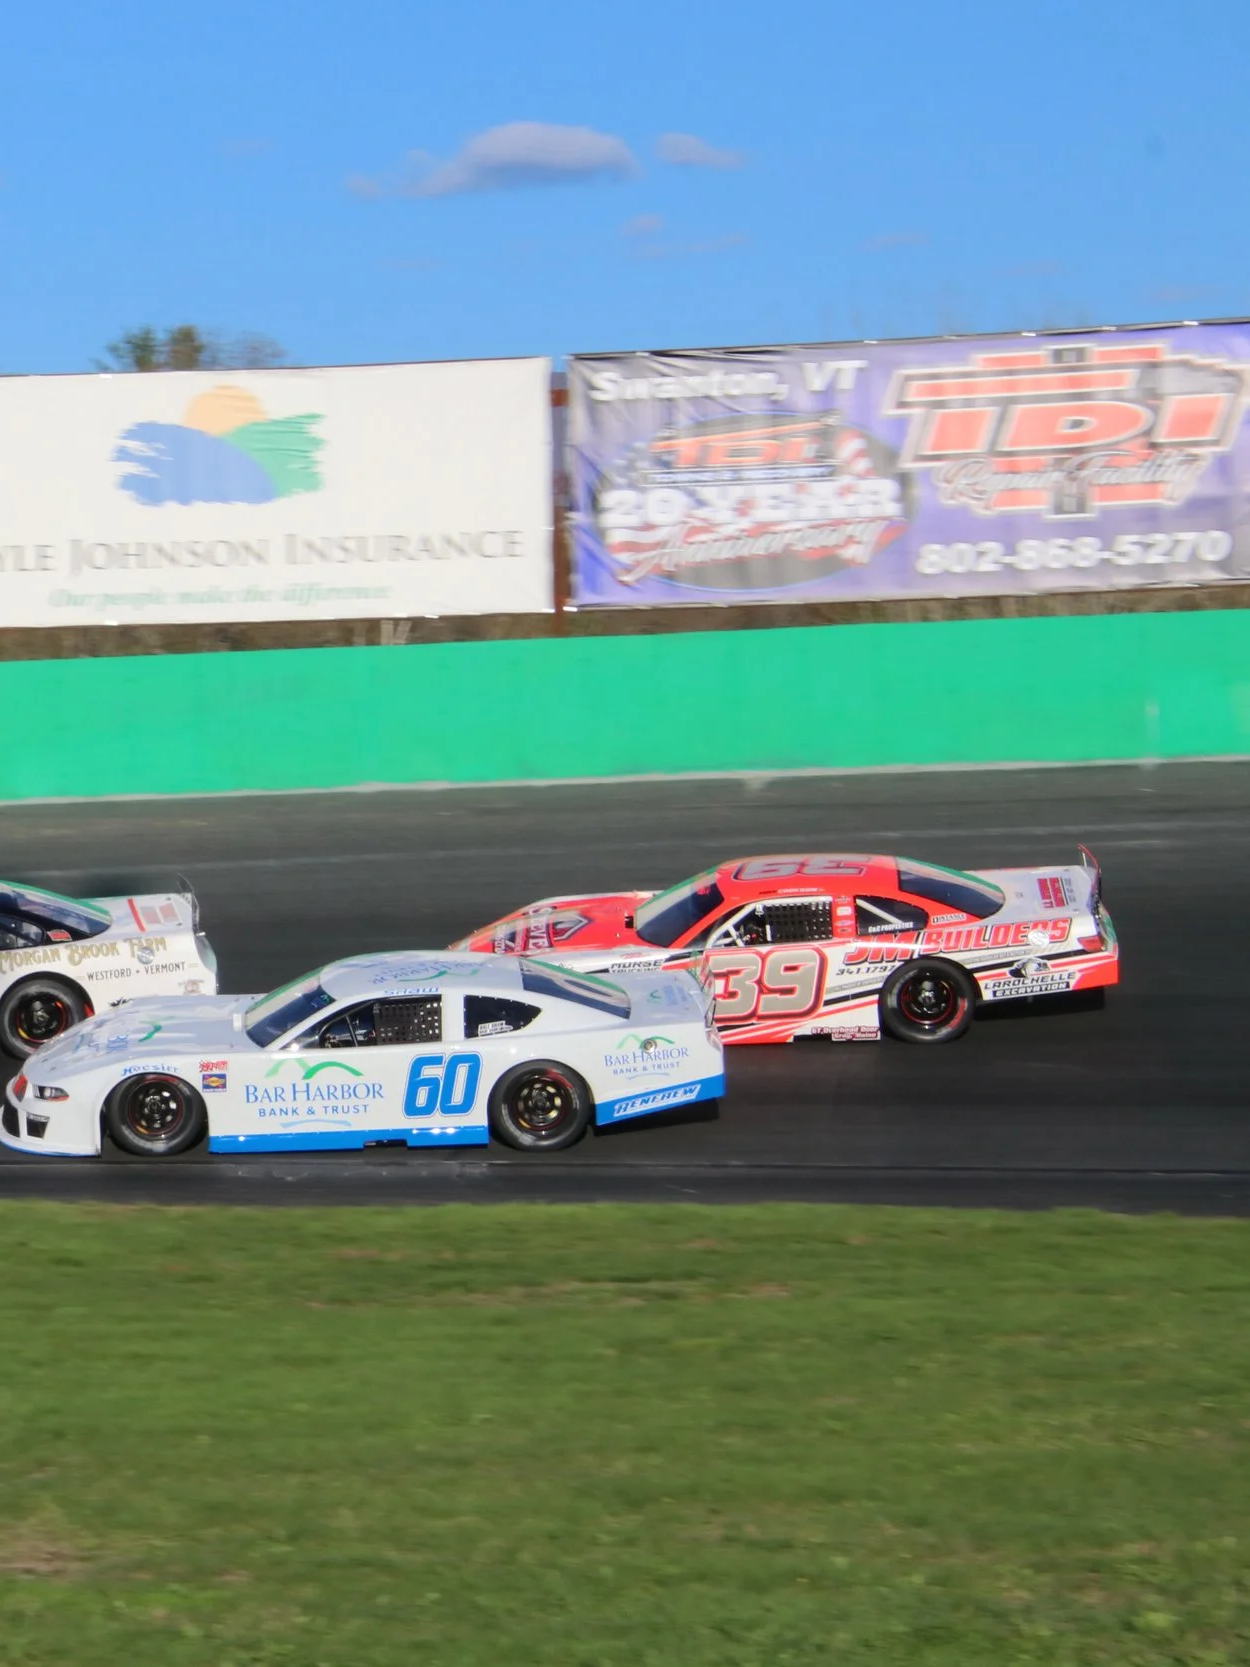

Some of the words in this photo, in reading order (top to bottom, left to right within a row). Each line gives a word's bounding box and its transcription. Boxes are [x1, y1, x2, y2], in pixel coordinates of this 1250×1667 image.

[802, 360, 868, 392] VT
[67, 537, 269, 575] JOHNSON
[282, 529, 526, 567] INSURANCE
[916, 529, 1233, 575] 802-868-5270
[67, 941, 120, 966] BROOK
[123, 936, 168, 958] FARM
[86, 968, 132, 981] WESTFORD
[143, 961, 186, 975] VERMONT
[983, 971, 1077, 990] LAROCHELLE
[706, 945, 827, 1022] 39
[994, 981, 1067, 997] EXCAVATION
[604, 1053, 630, 1067] BAR
[632, 1047, 690, 1064] HARBOR
[612, 1067, 638, 1075] BANK
[652, 1061, 680, 1070] TRUST
[244, 1084, 286, 1104] BAR
[291, 1082, 386, 1102] HARBOR
[402, 1051, 483, 1119] 60
[258, 1107, 299, 1117] BANK
[306, 1105, 316, 1115] &
[323, 1104, 370, 1115] TRUST
